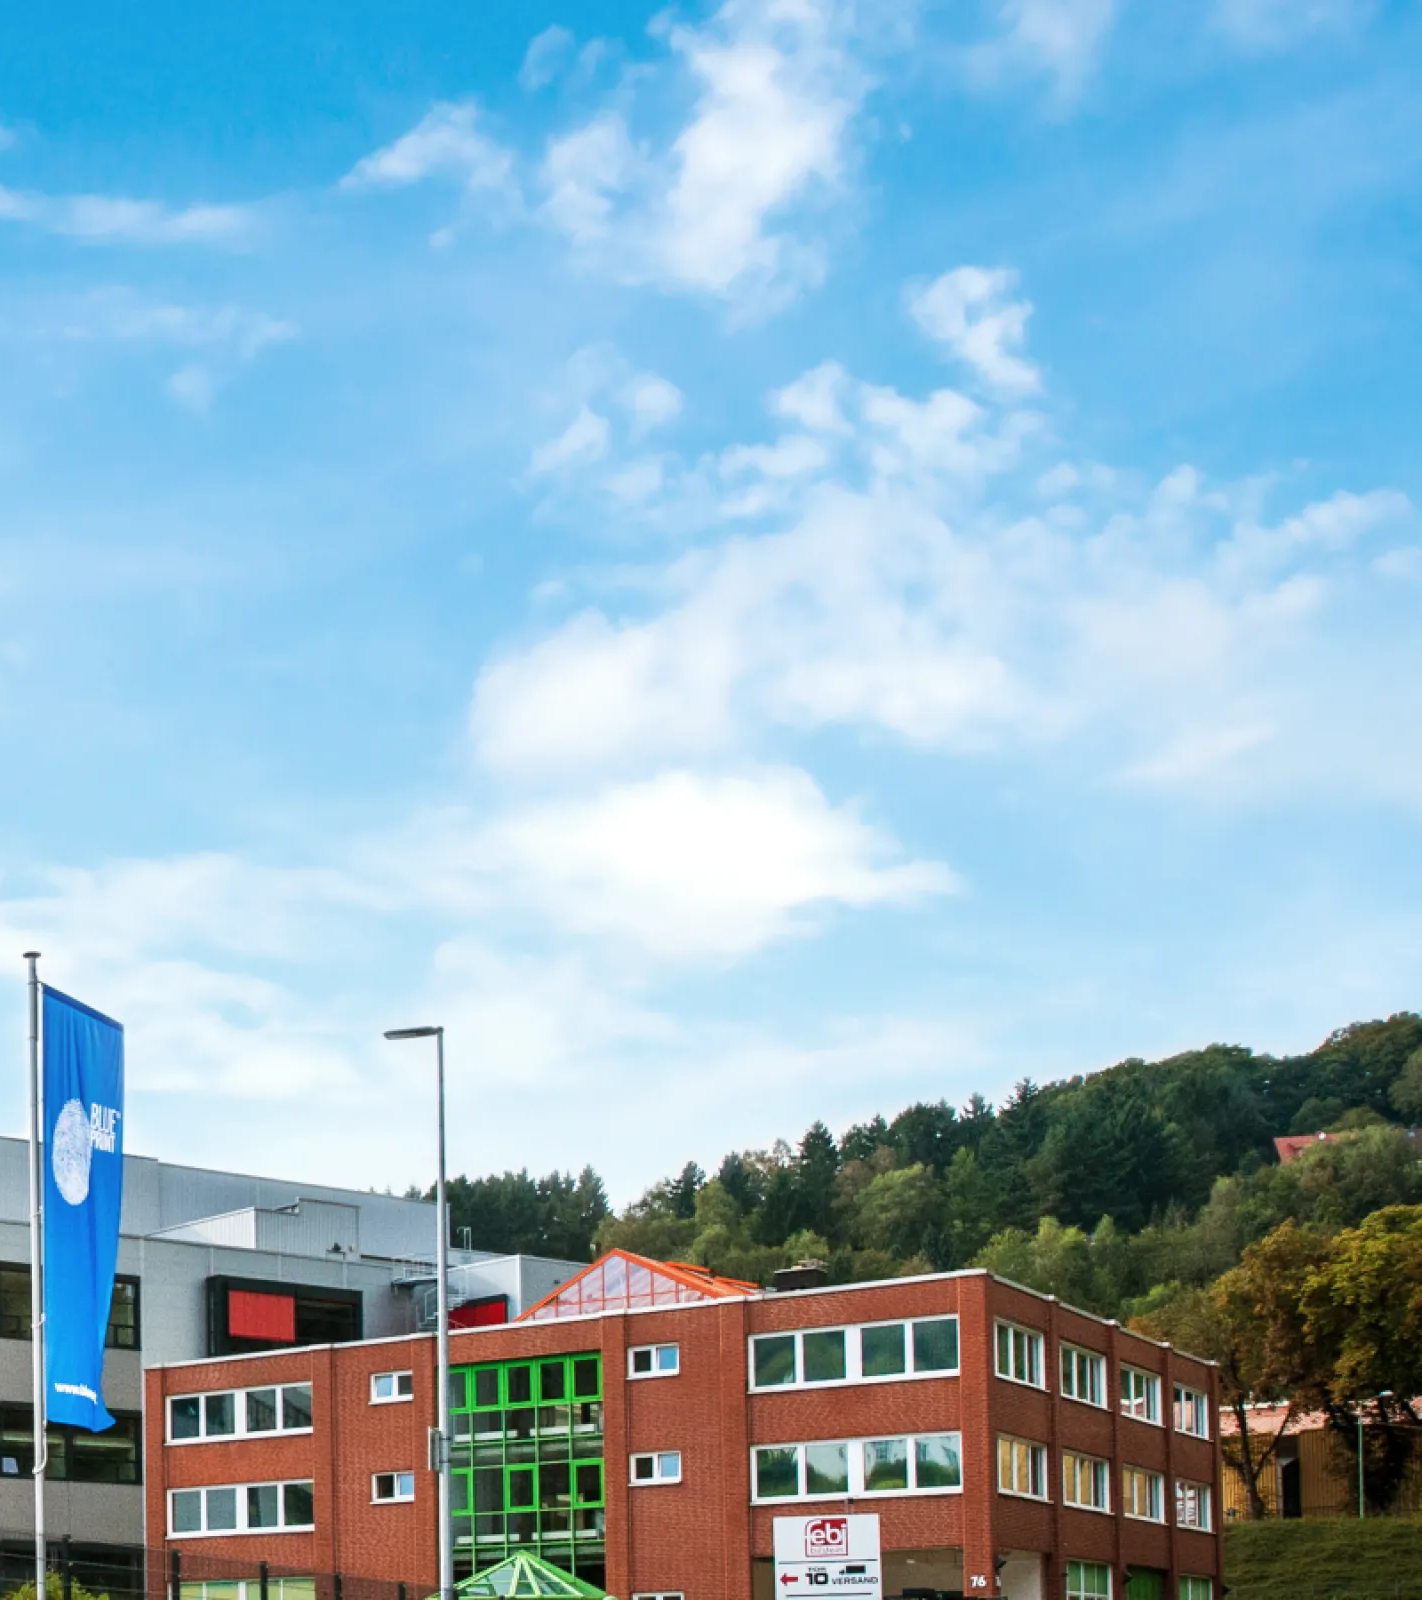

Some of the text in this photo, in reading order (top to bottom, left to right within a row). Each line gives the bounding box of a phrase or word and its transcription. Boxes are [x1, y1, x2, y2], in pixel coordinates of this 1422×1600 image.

[805, 1519, 847, 1545] febi
[805, 1573, 878, 1585] 10 VERSAND
[970, 1575, 987, 1588] 76
